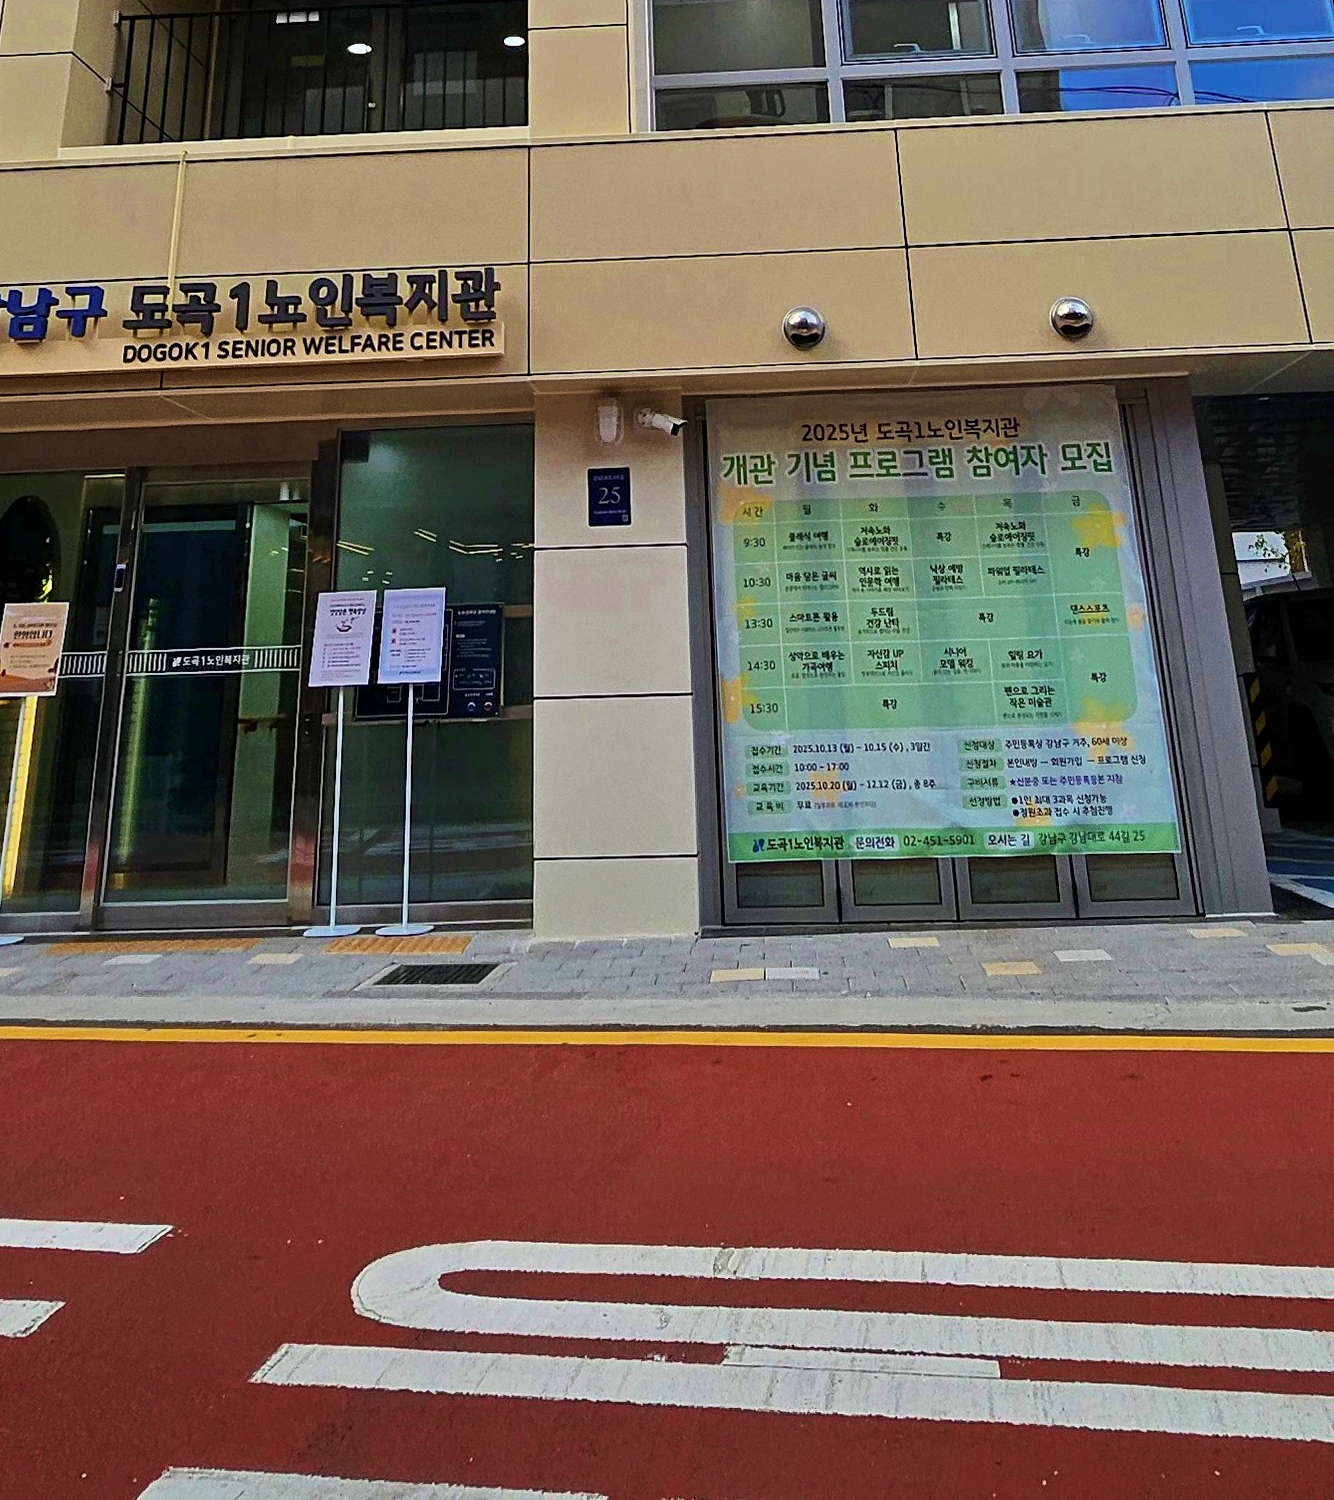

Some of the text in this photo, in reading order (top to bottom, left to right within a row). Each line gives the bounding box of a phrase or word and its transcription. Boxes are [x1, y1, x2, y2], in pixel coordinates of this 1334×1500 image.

[122, 267, 502, 336] 도곡1노인복지관
[122, 328, 496, 364] DOGOK1 SENIOR WELFARE CENTER
[801, 416, 1021, 443] 2025년 도곡1노인복지관
[723, 441, 1113, 486] 개관 기념 프로그램 참여자 모집
[598, 486, 621, 504] 25
[1072, 495, 1081, 507] 금
[868, 503, 879, 514] 화
[743, 537, 766, 548] 9:30
[743, 577, 771, 588] 10:30
[745, 618, 773, 629] 13:30
[893, 649, 905, 658] UP
[747, 660, 776, 671] 14:30
[750, 703, 779, 714] 15:30
[793, 744, 837, 754] 2025.10.13
[864, 742, 887, 752] 10.15
[794, 763, 817, 772] 10:00
[827, 762, 849, 772] 17:00
[796, 781, 841, 791] 2025.10.20
[867, 779, 889, 789] 12.12
[767, 836, 844, 852] 도곡1노인복지관
[855, 836, 896, 850] 문의전화
[903, 834, 976, 847] 02-451-5901
[987, 834, 1017, 846] 오시는
[1020, 834, 1030, 846] 길
[1038, 833, 1066, 846] 강남구
[1069, 831, 1106, 845] 강남대로
[1133, 829, 1146, 841] 25
